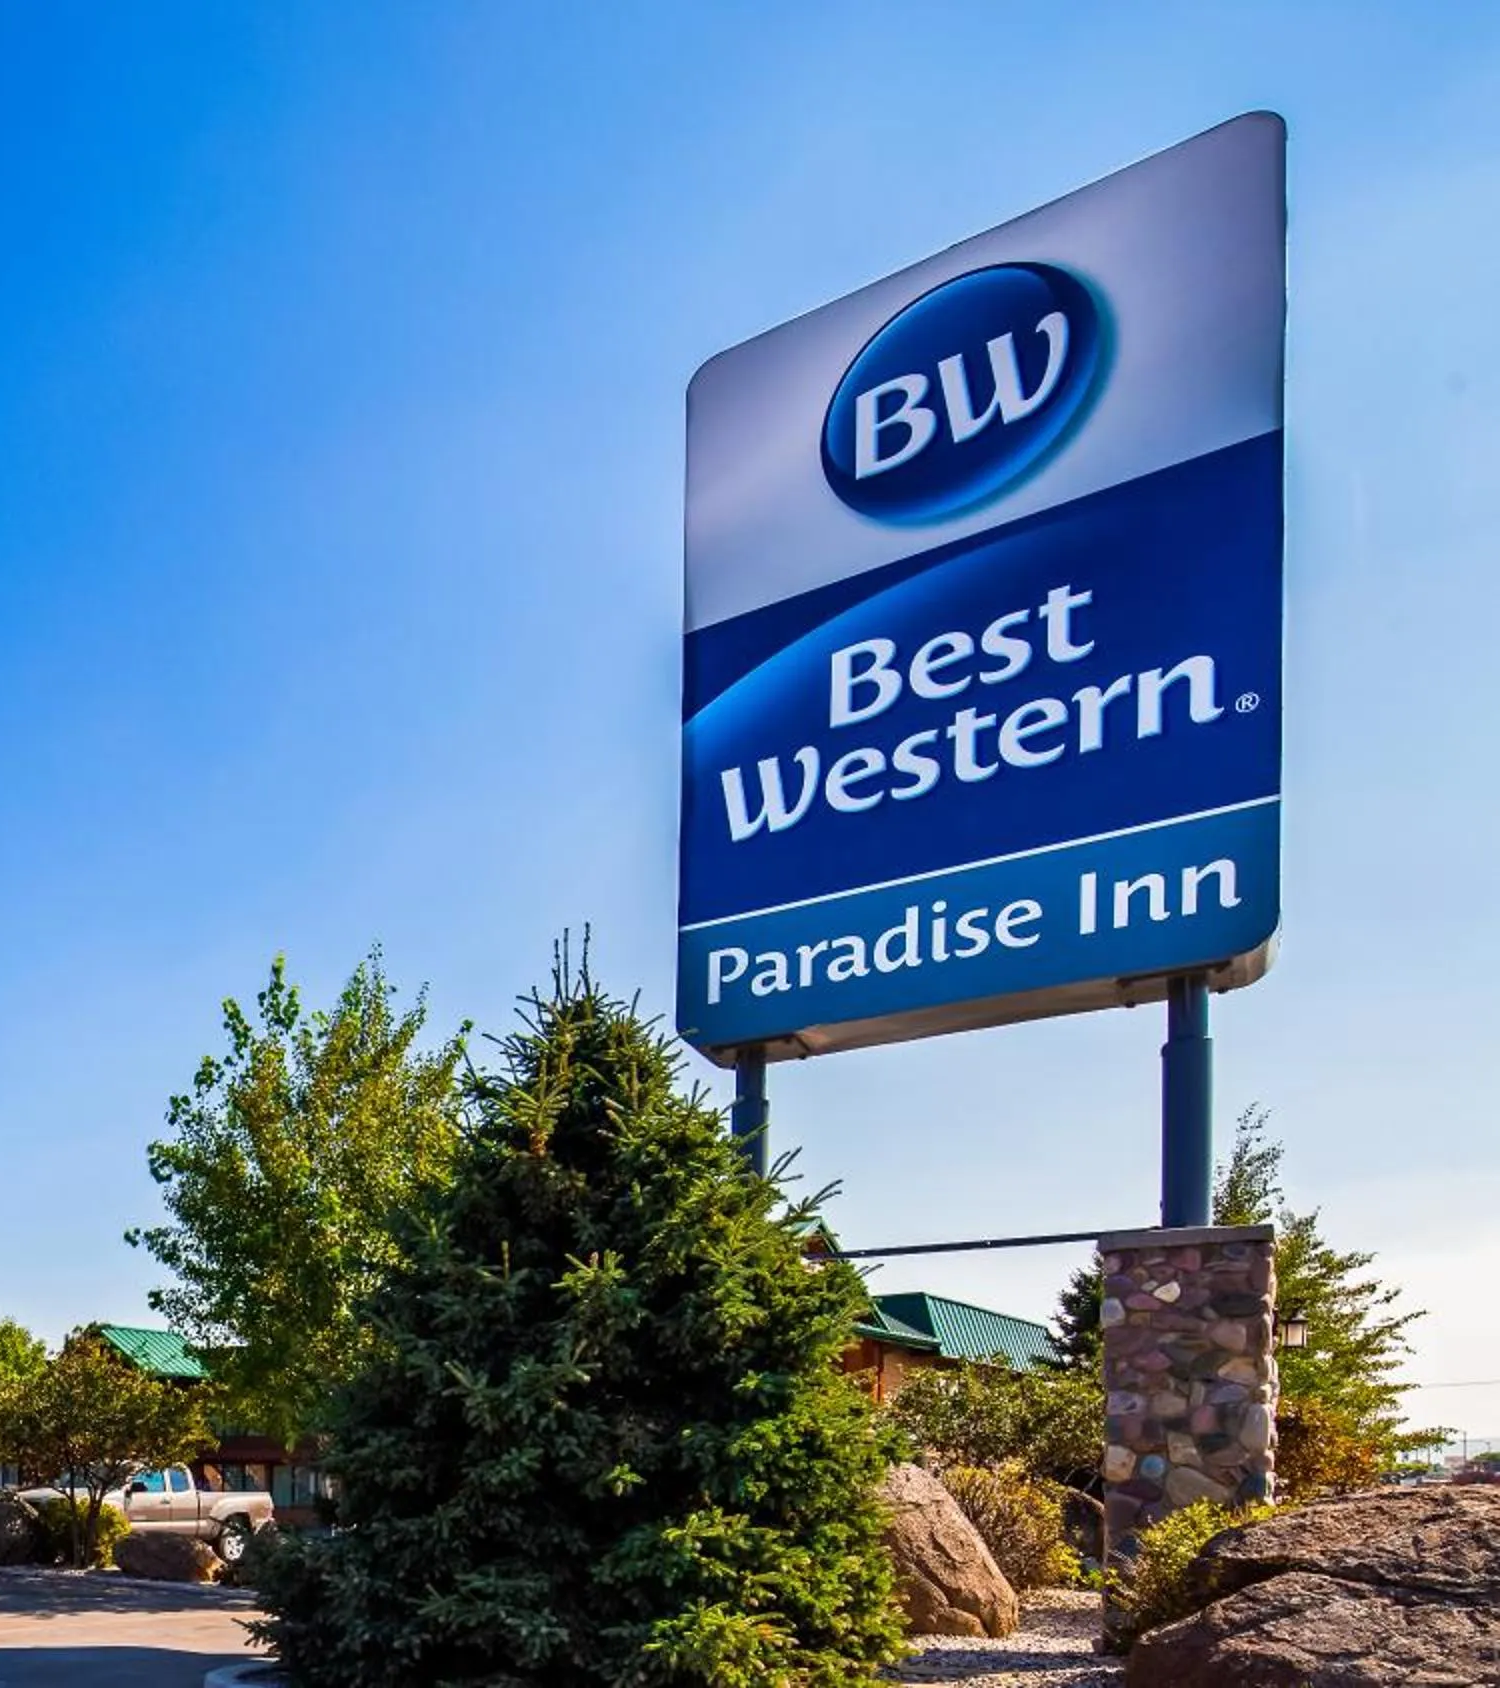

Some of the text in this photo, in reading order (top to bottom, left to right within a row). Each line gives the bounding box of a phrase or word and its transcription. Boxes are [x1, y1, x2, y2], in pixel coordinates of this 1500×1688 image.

[855, 311, 1070, 480] BW
[829, 584, 1095, 729] Best
[720, 655, 1225, 842] Western
[707, 857, 1242, 1004] Paradise Inn
